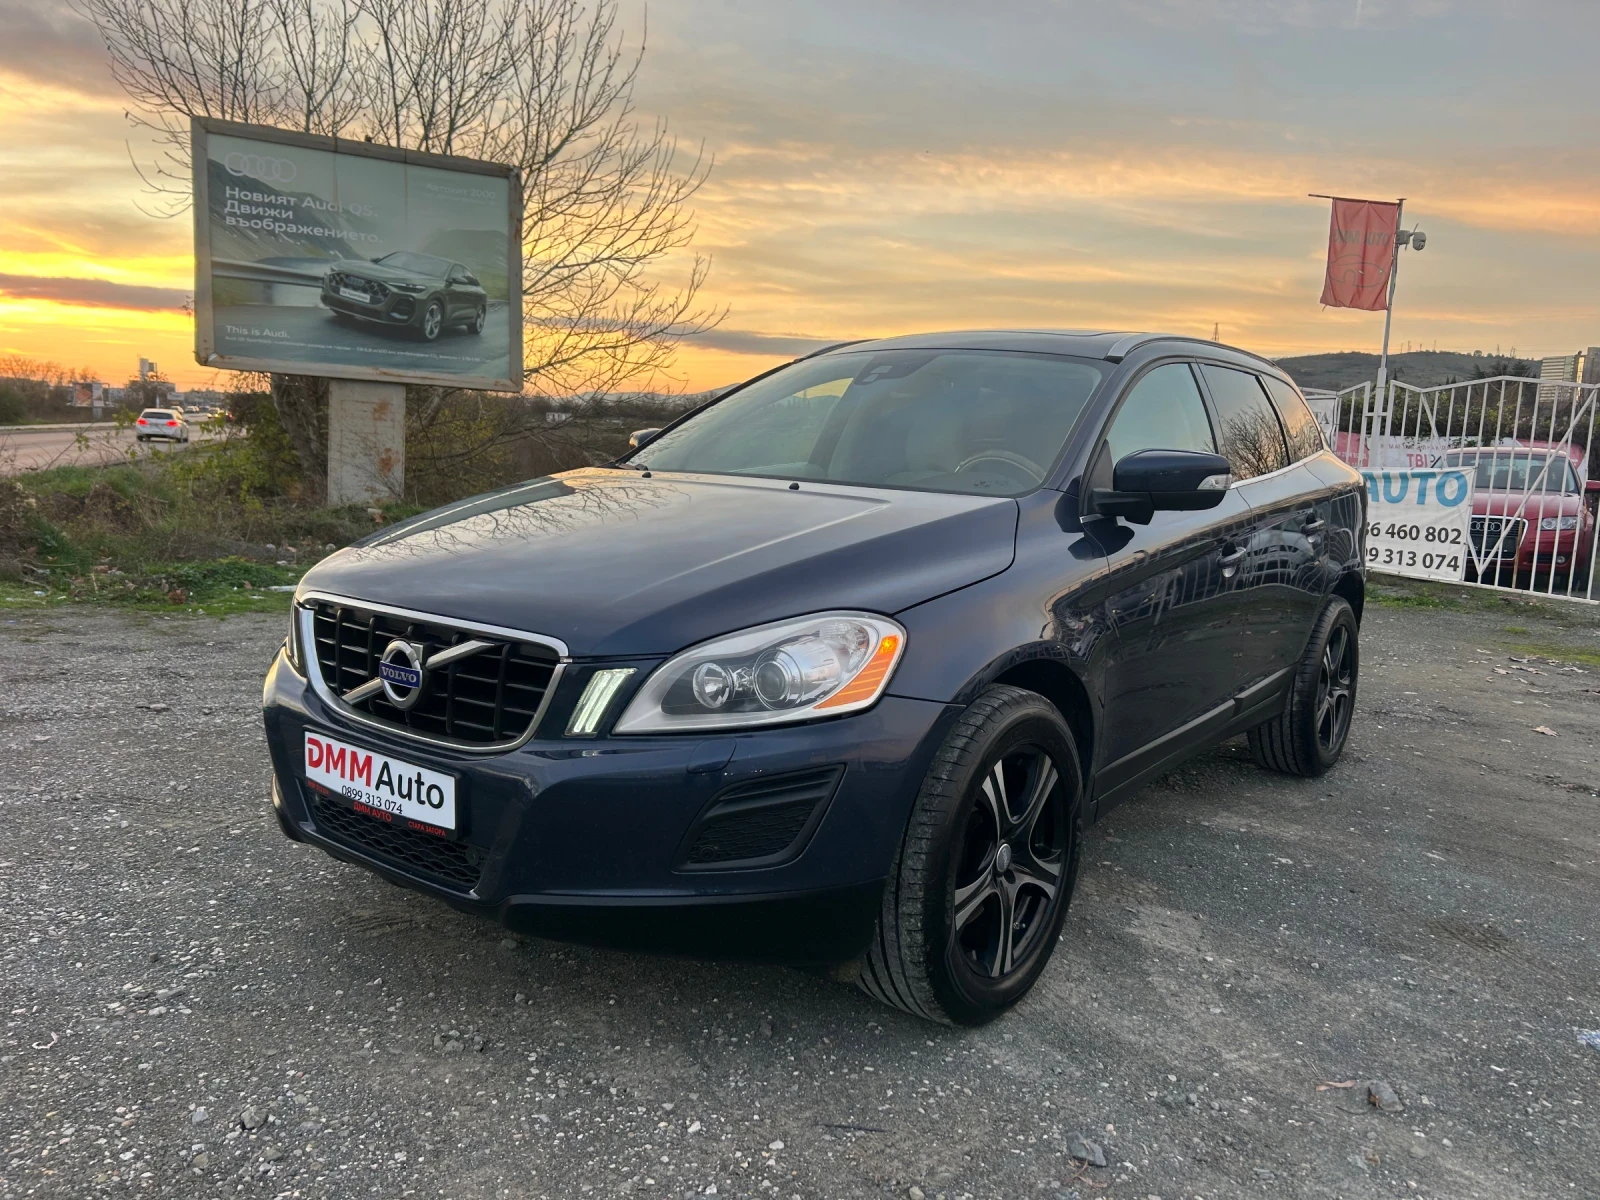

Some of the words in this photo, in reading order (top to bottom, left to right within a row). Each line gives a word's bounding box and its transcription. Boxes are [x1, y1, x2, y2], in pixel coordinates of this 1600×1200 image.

[224, 200, 293, 219] Движи
[225, 186, 298, 206] Новият
[301, 196, 343, 213] Audi
[225, 215, 383, 244] въображението.
[225, 325, 249, 335] This
[251, 328, 260, 336] is
[263, 328, 291, 339] Audi.
[1385, 523, 1420, 541] 460
[1424, 526, 1462, 545] 802
[1366, 547, 1379, 562] 9
[1383, 548, 1417, 567] 313
[1422, 553, 1460, 572] 074
[381, 666, 417, 683] VOLVO
[341, 785, 363, 801] 0899
[365, 792, 382, 808] 313
[384, 799, 403, 814] 074
[353, 801, 371, 815] ДММ
[372, 809, 393, 822] АУТО
